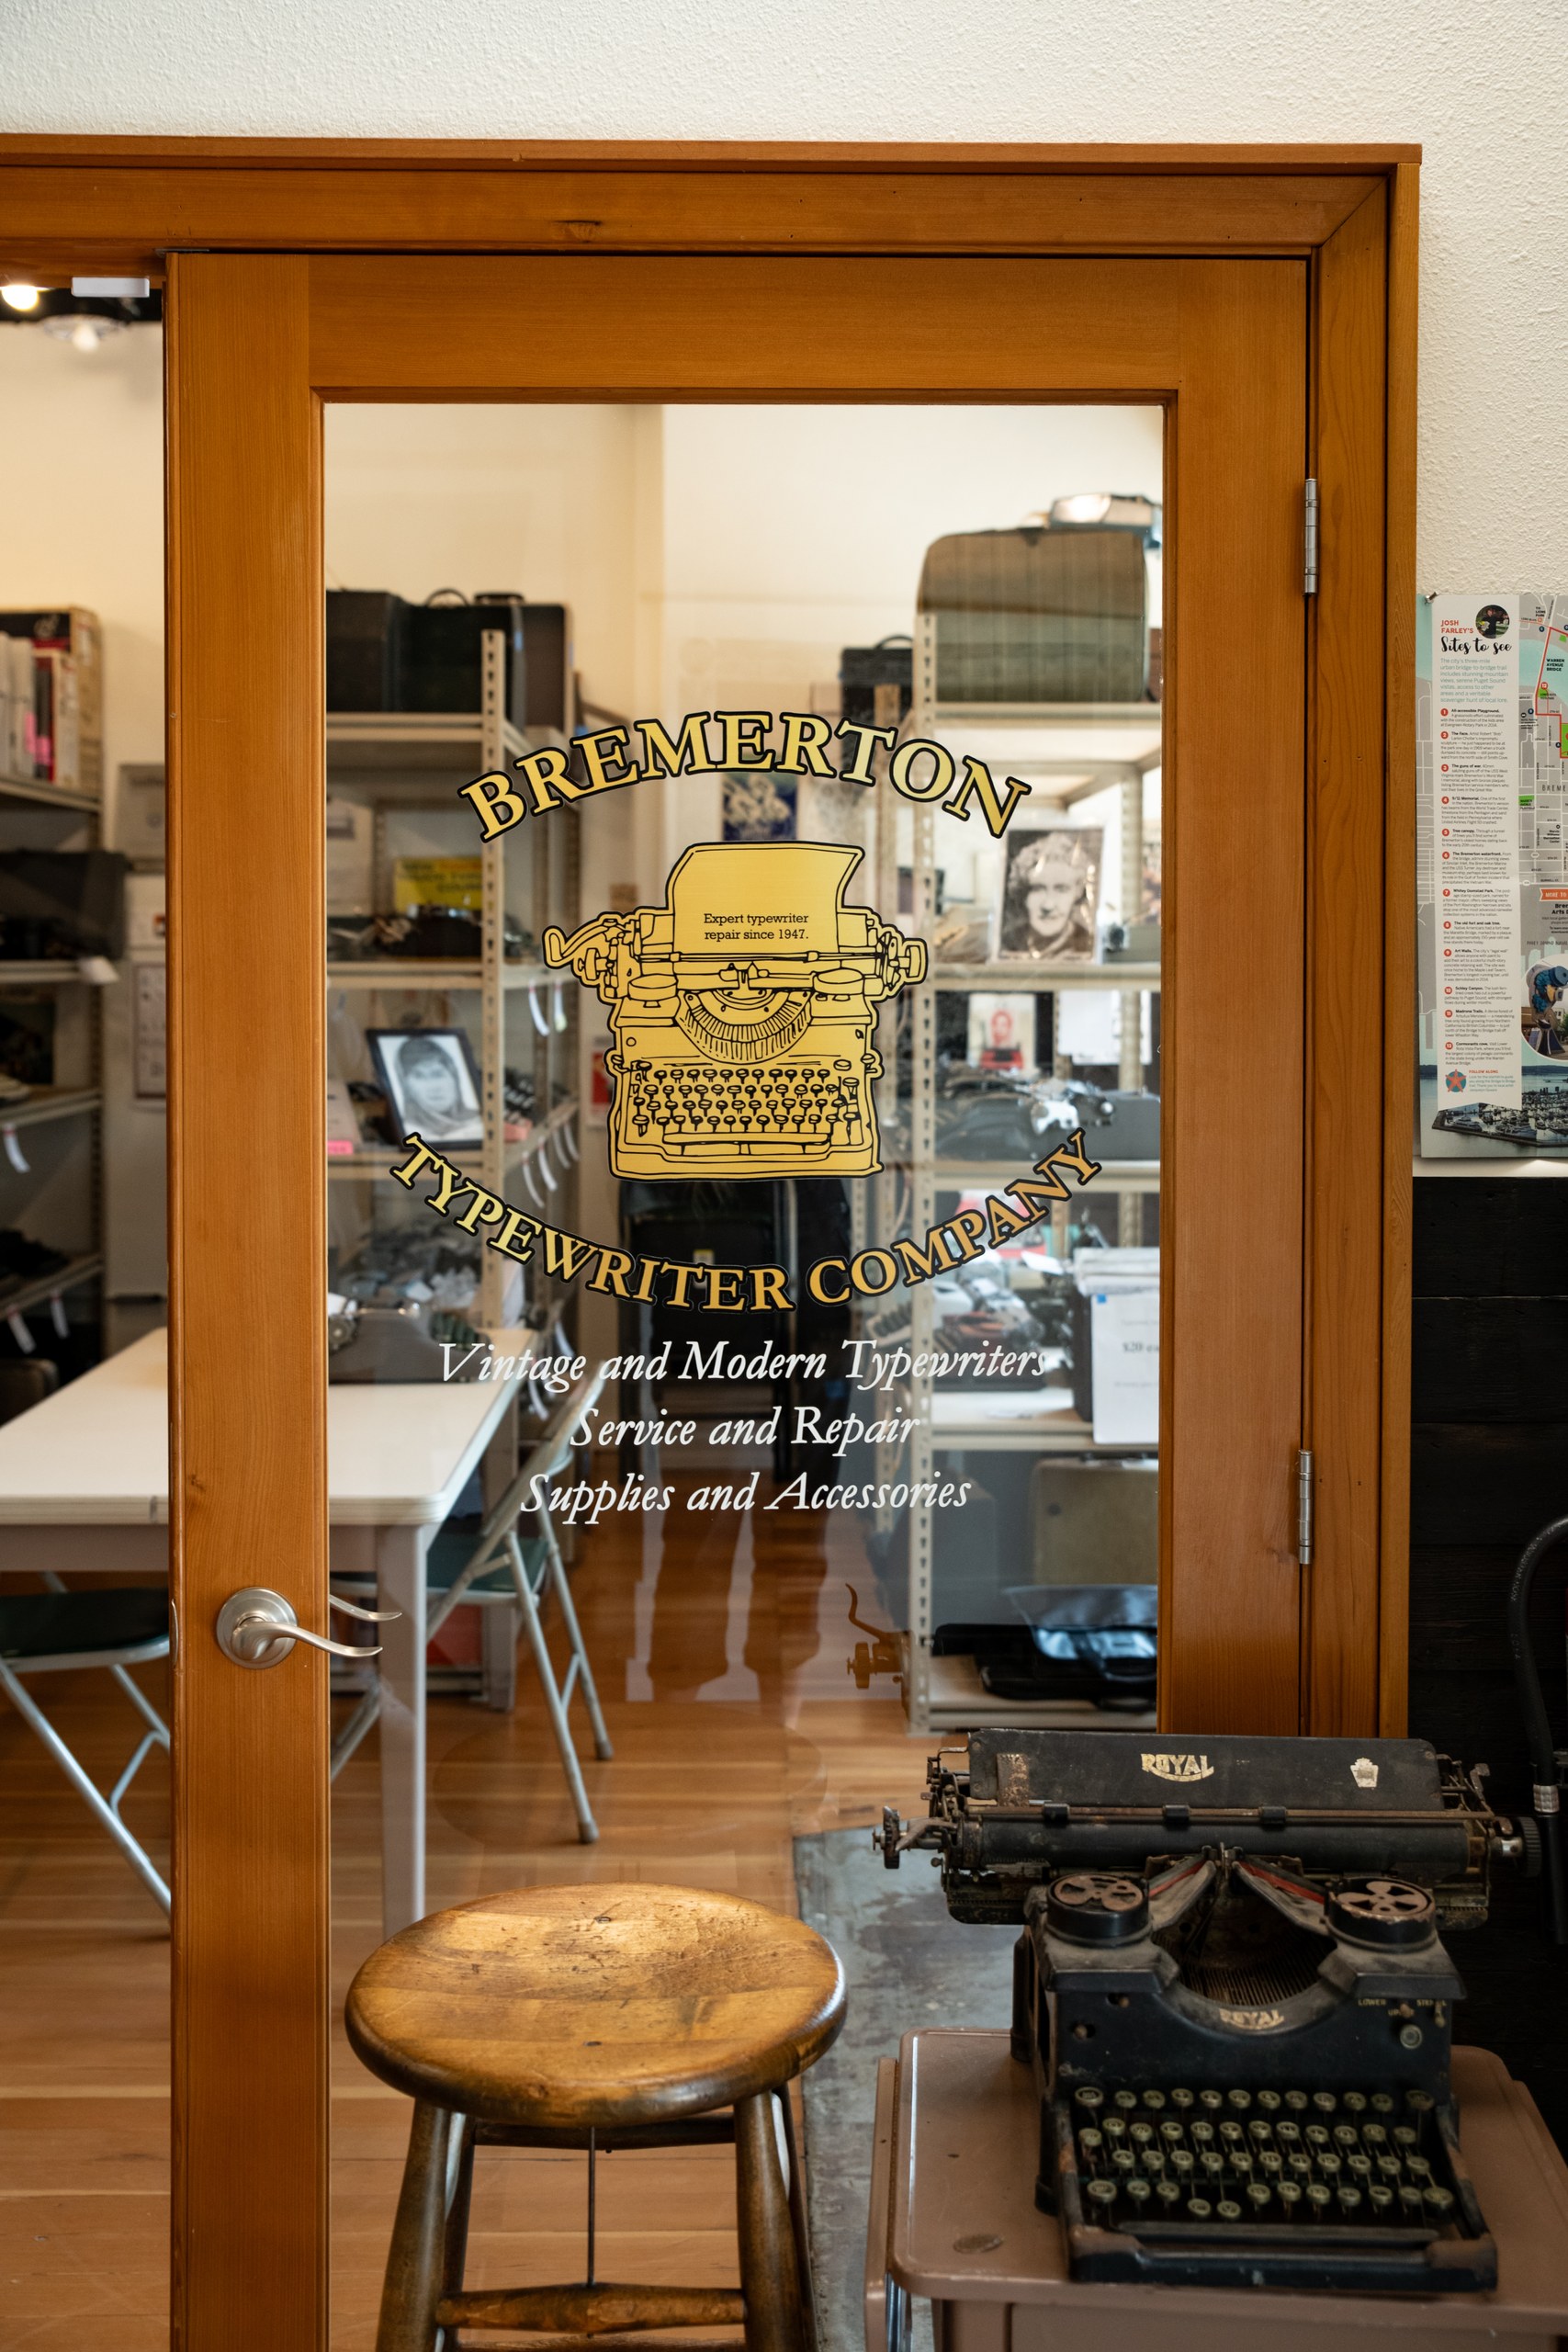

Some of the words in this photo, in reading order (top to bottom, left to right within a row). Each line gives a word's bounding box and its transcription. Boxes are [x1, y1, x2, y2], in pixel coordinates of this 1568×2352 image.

[1441, 636, 1471, 655] Sites
[1472, 638, 1489, 653] to
[1493, 642, 1512, 655] see
[458, 710, 1032, 842] BREMERTON
[704, 913, 744, 926] Expert
[747, 913, 809, 926] typewriter
[705, 930, 741, 942] repair
[743, 930, 774, 940] since
[778, 929, 809, 940] 1947.
[390, 1134, 795, 1313] TYPEWRITER
[808, 1127, 1103, 1307] COMPANY
[439, 1341, 587, 1394] Vintage
[599, 1342, 673, 1382] and
[678, 1340, 827, 1382] Modern
[840, 1339, 1047, 1392] Typewriters
[570, 1406, 695, 1447] Service
[708, 1406, 783, 1446] and
[790, 1406, 921, 1457] Repair
[520, 1472, 676, 1525] Supplies
[686, 1471, 761, 1512] and
[764, 1471, 972, 1511] Accessories
[1141, 1753, 1214, 1781] ROYAL
[1219, 2007, 1284, 2030] ROYAL
